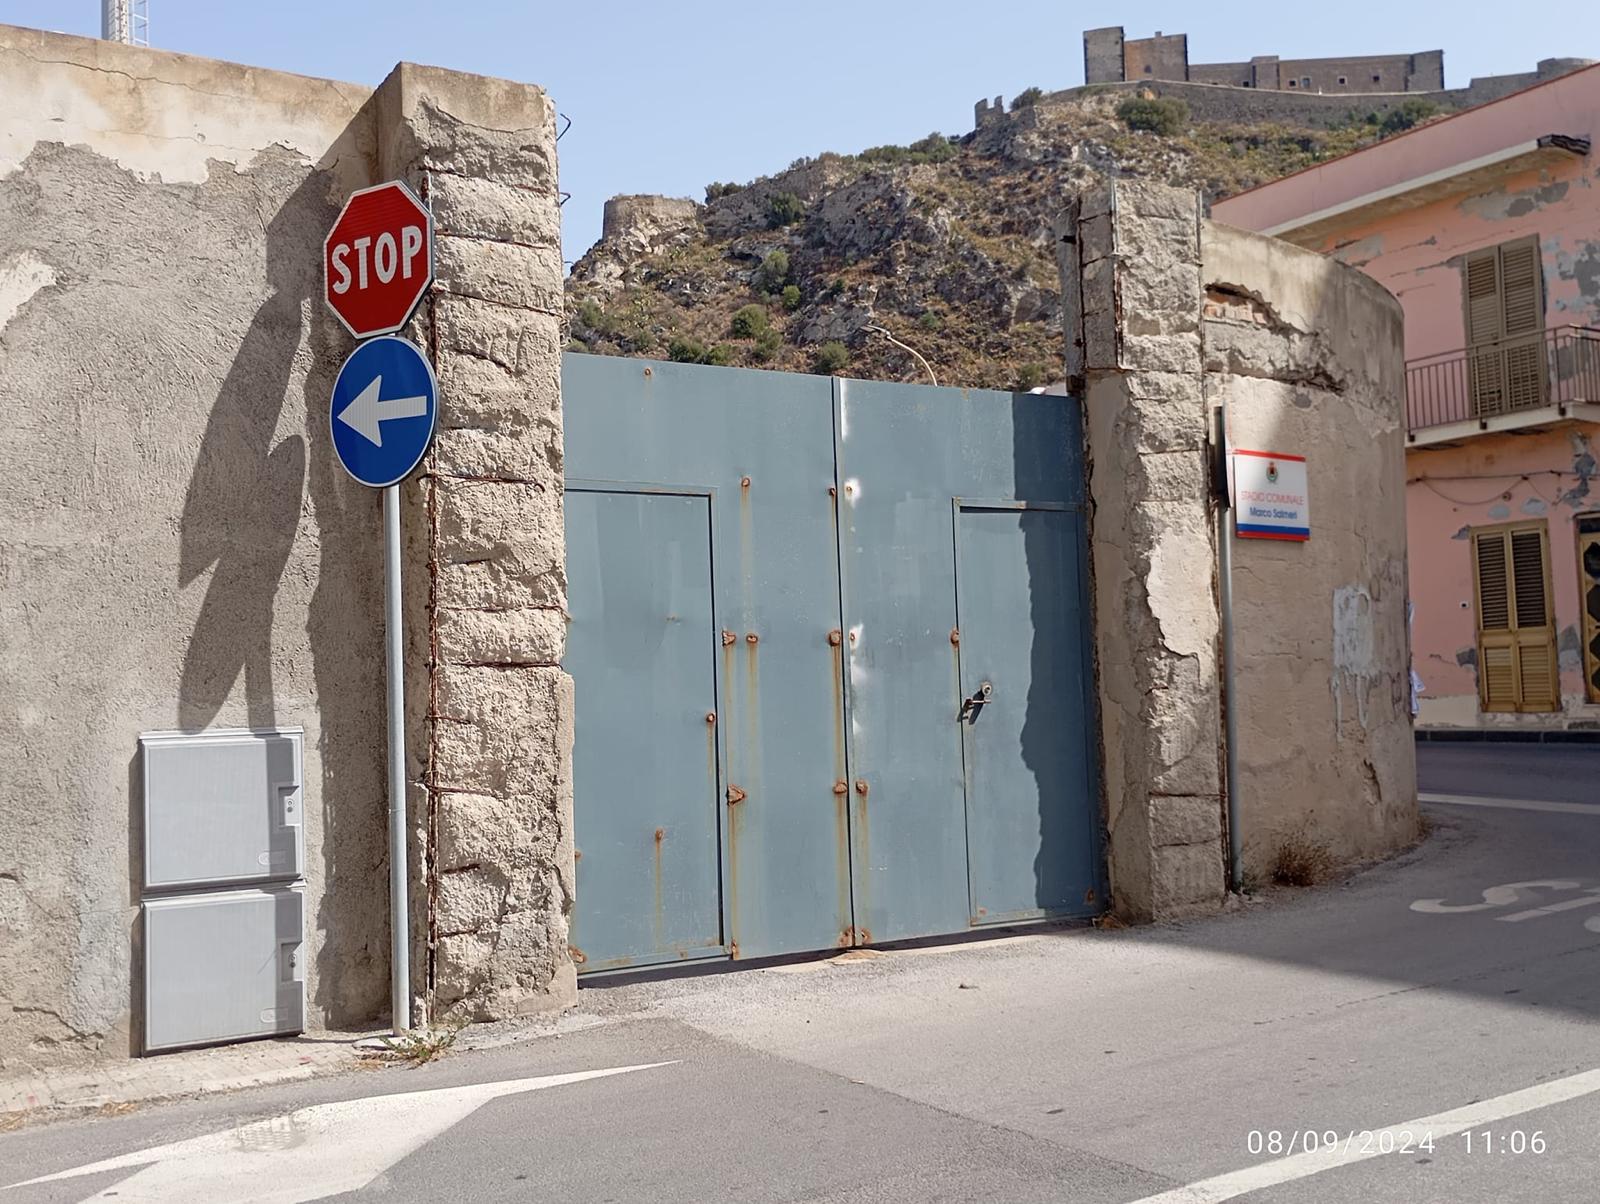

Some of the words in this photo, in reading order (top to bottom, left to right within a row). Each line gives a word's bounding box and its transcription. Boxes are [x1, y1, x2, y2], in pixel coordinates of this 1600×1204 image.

[331, 225, 422, 294] STOP
[1241, 491, 1264, 502] STADIO
[1267, 493, 1305, 505] COMUNALE
[1249, 507, 1272, 518] Marco
